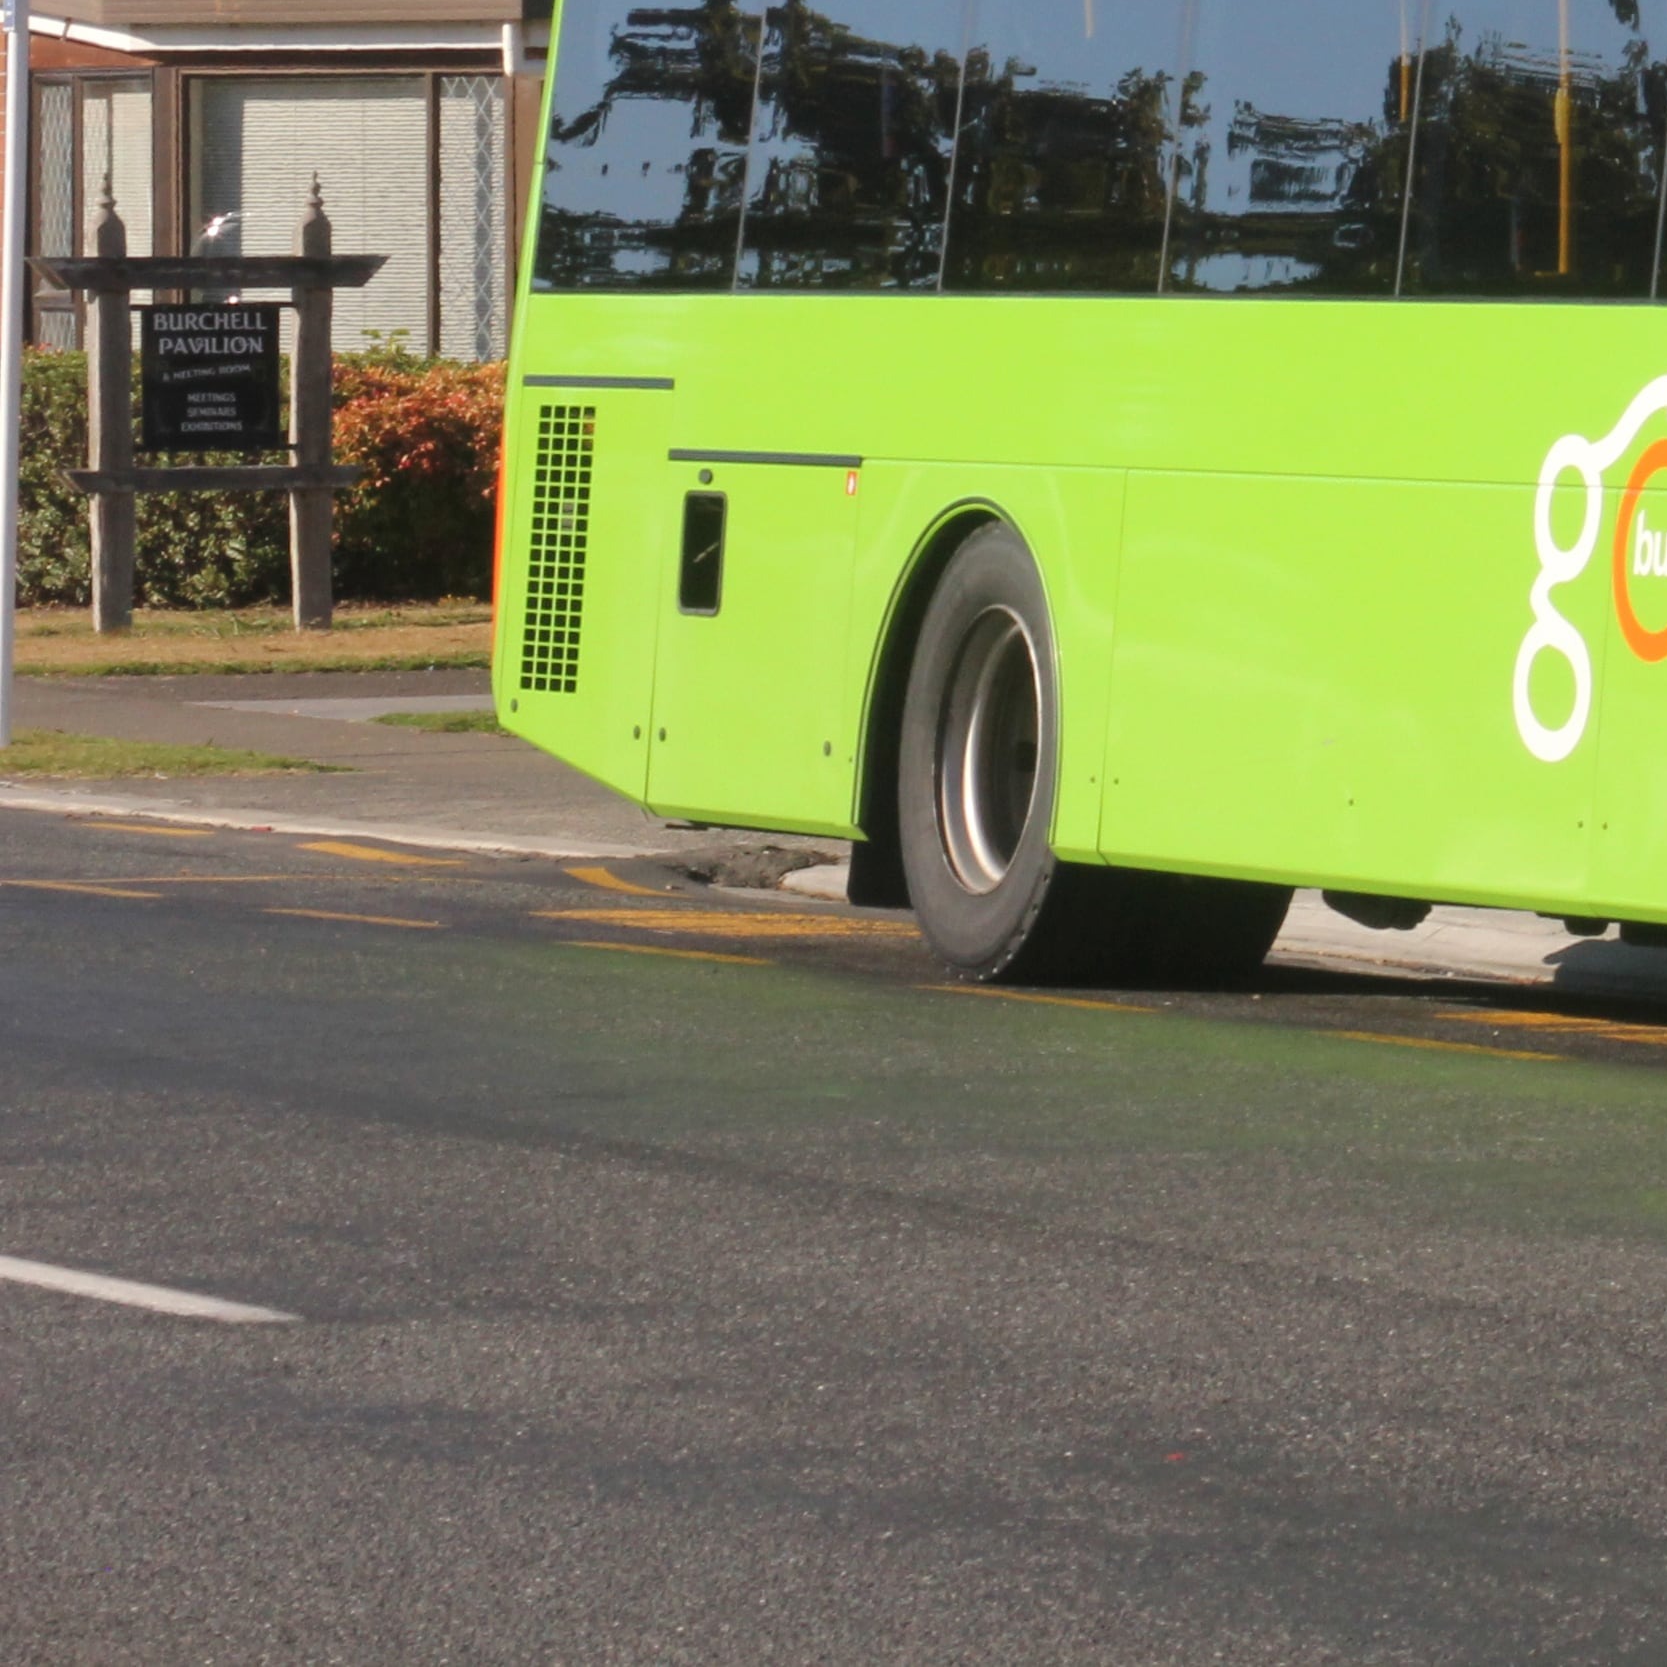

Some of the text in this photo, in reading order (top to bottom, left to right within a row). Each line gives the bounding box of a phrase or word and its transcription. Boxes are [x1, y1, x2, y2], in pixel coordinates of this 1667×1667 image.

[153, 312, 267, 331] BURCHELL
[159, 337, 263, 355] PAVILION
[174, 368, 216, 380] MEETING
[187, 393, 236, 403] MEETINGS
[187, 407, 236, 417] SEMINARS
